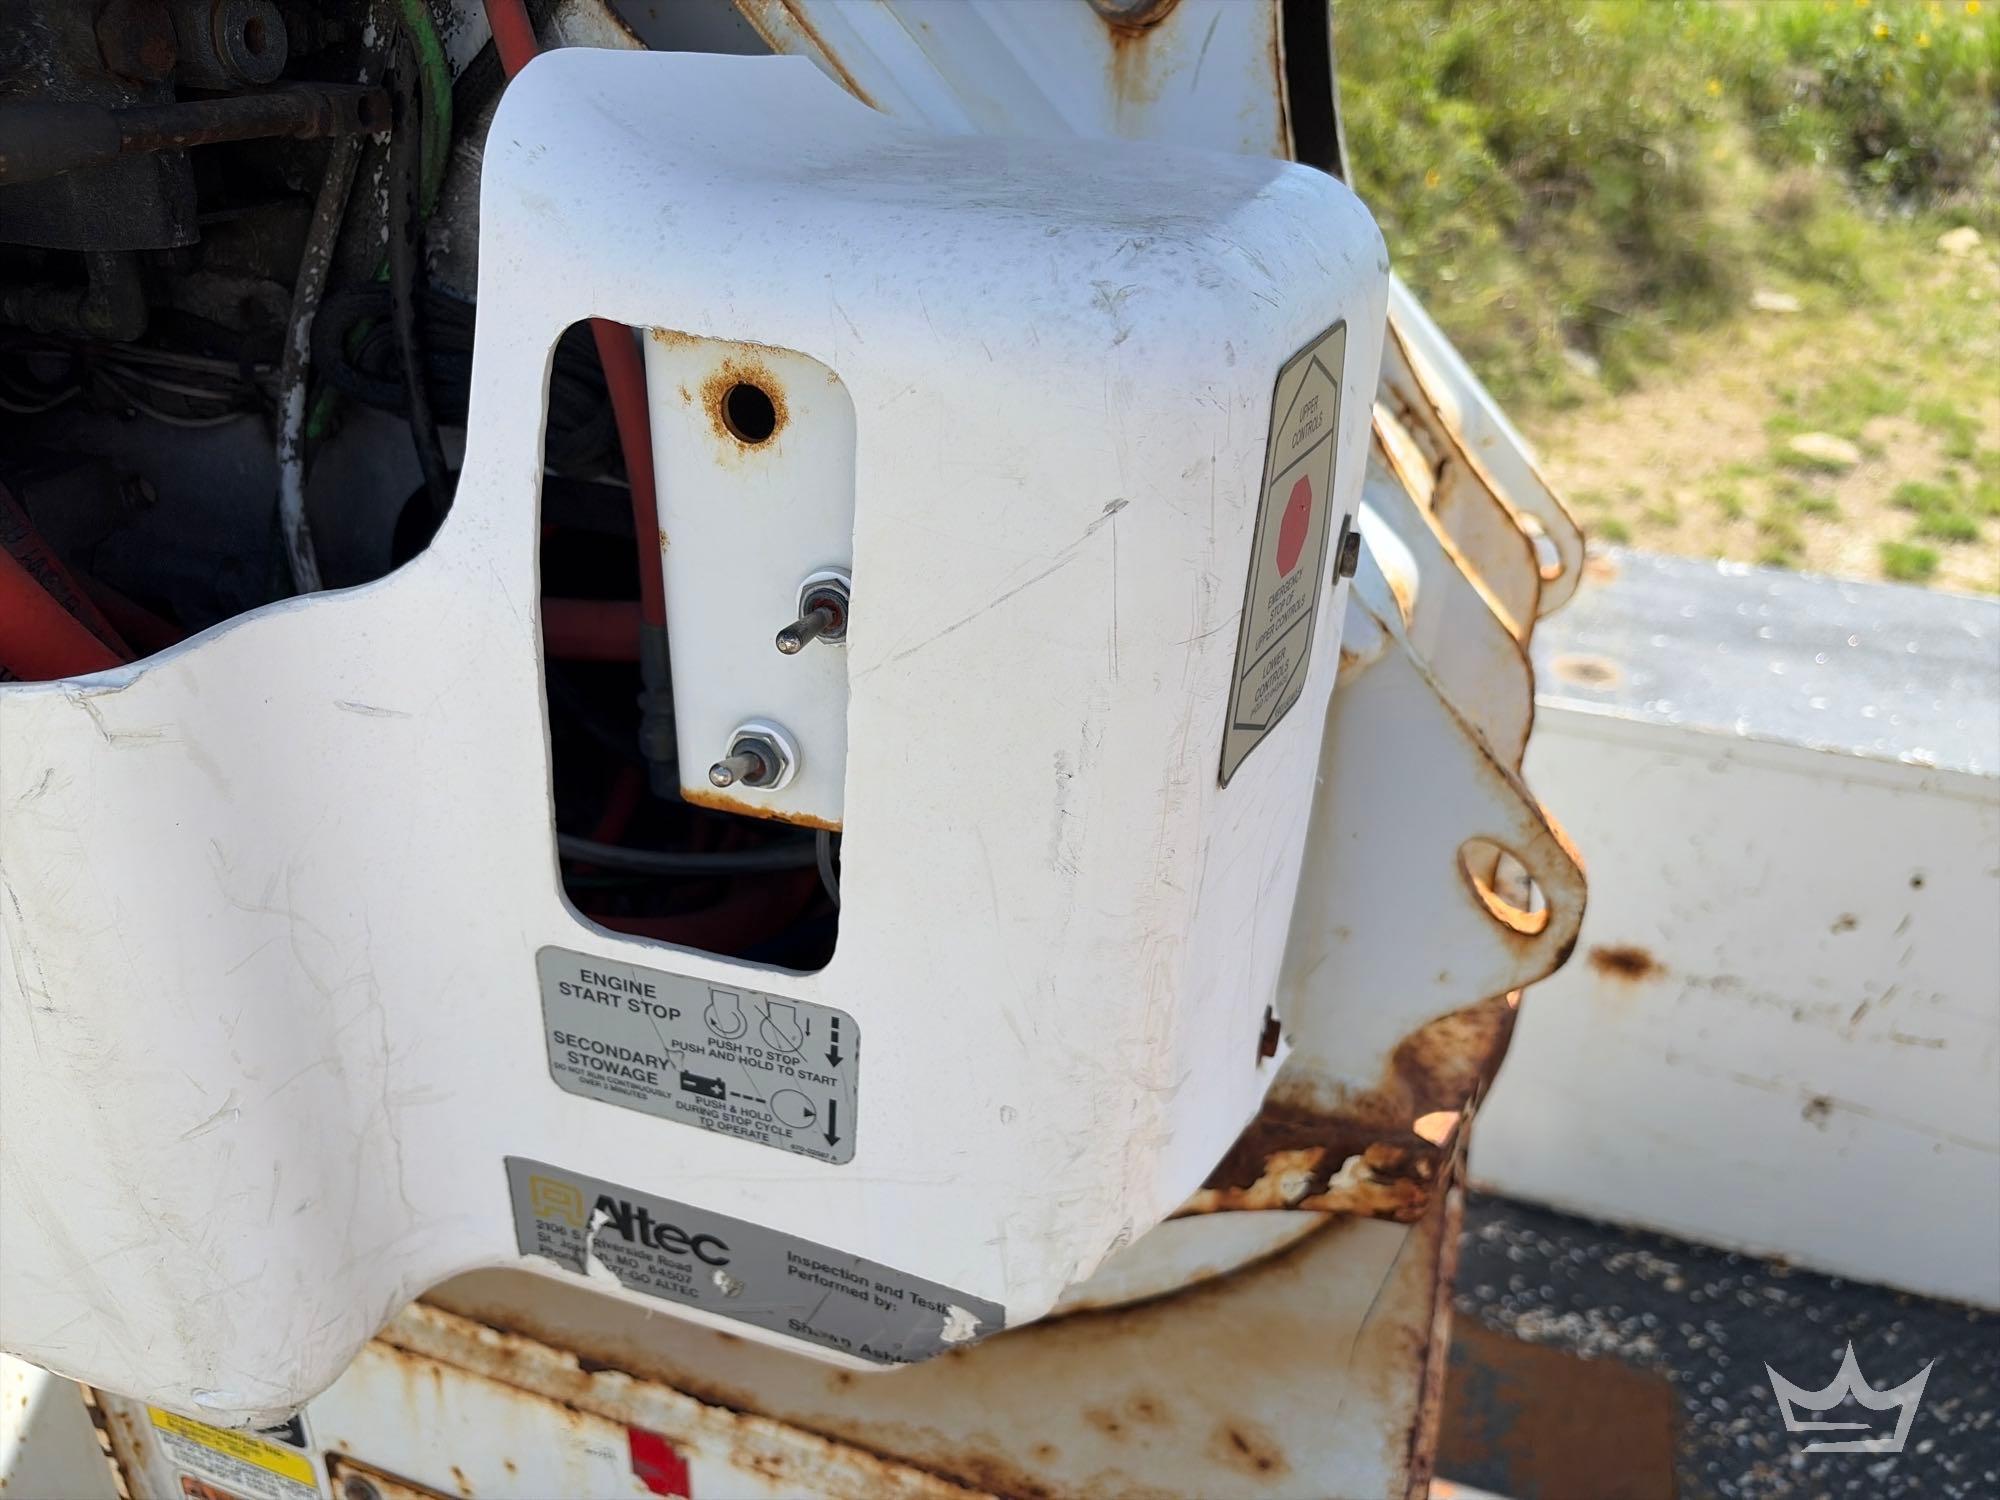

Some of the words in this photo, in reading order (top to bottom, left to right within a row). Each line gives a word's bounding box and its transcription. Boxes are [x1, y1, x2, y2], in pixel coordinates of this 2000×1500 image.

[1299, 394, 1319, 424] UPPER
[1291, 410, 1323, 449] CONTROLS
[1267, 566, 1304, 610] EMERGENCY
[1269, 598, 1286, 623] STOP
[1286, 589, 1295, 607] OF
[1255, 622, 1275, 652] UPPER
[1275, 592, 1306, 632] CONTROLS
[1254, 657, 1290, 702] CONTROLS
[1262, 646, 1287, 680] LOWER
[559, 981, 622, 1008] START
[627, 998, 681, 1021] STOP
[580, 968, 657, 999] ENGINE
[553, 1030, 669, 1071] SECONDARY
[567, 1050, 659, 1086] STOWAGE
[671, 1039, 705, 1055] PUSH
[708, 1049, 735, 1062] AND
[739, 1055, 774, 1071] HOLD
[777, 1064, 795, 1076] TO
[798, 1069, 838, 1087] START
[707, 1037, 742, 1052] PUSH
[746, 1046, 763, 1058] TO
[766, 1050, 801, 1066] STOP
[675, 1100, 720, 1119] DURING
[722, 1112, 752, 1126] STOP
[755, 1119, 793, 1138] CYCLE
[695, 1095, 727, 1111] PUSH
[729, 1104, 737, 1113] &
[740, 1107, 773, 1122] HOLD
[700, 1116, 714, 1128] TO
[717, 1120, 769, 1142] OPERATE
[585, 1193, 731, 1267] Altec
[616, 1254, 640, 1270] MO
[657, 1254, 693, 1274] Road
[655, 1278, 700, 1299] ALTEC
[787, 1250, 870, 1288] Inspection
[874, 1281, 905, 1300] and
[908, 1290, 952, 1317] Testi
[787, 1264, 870, 1302] Performed
[873, 1293, 898, 1313] by:
